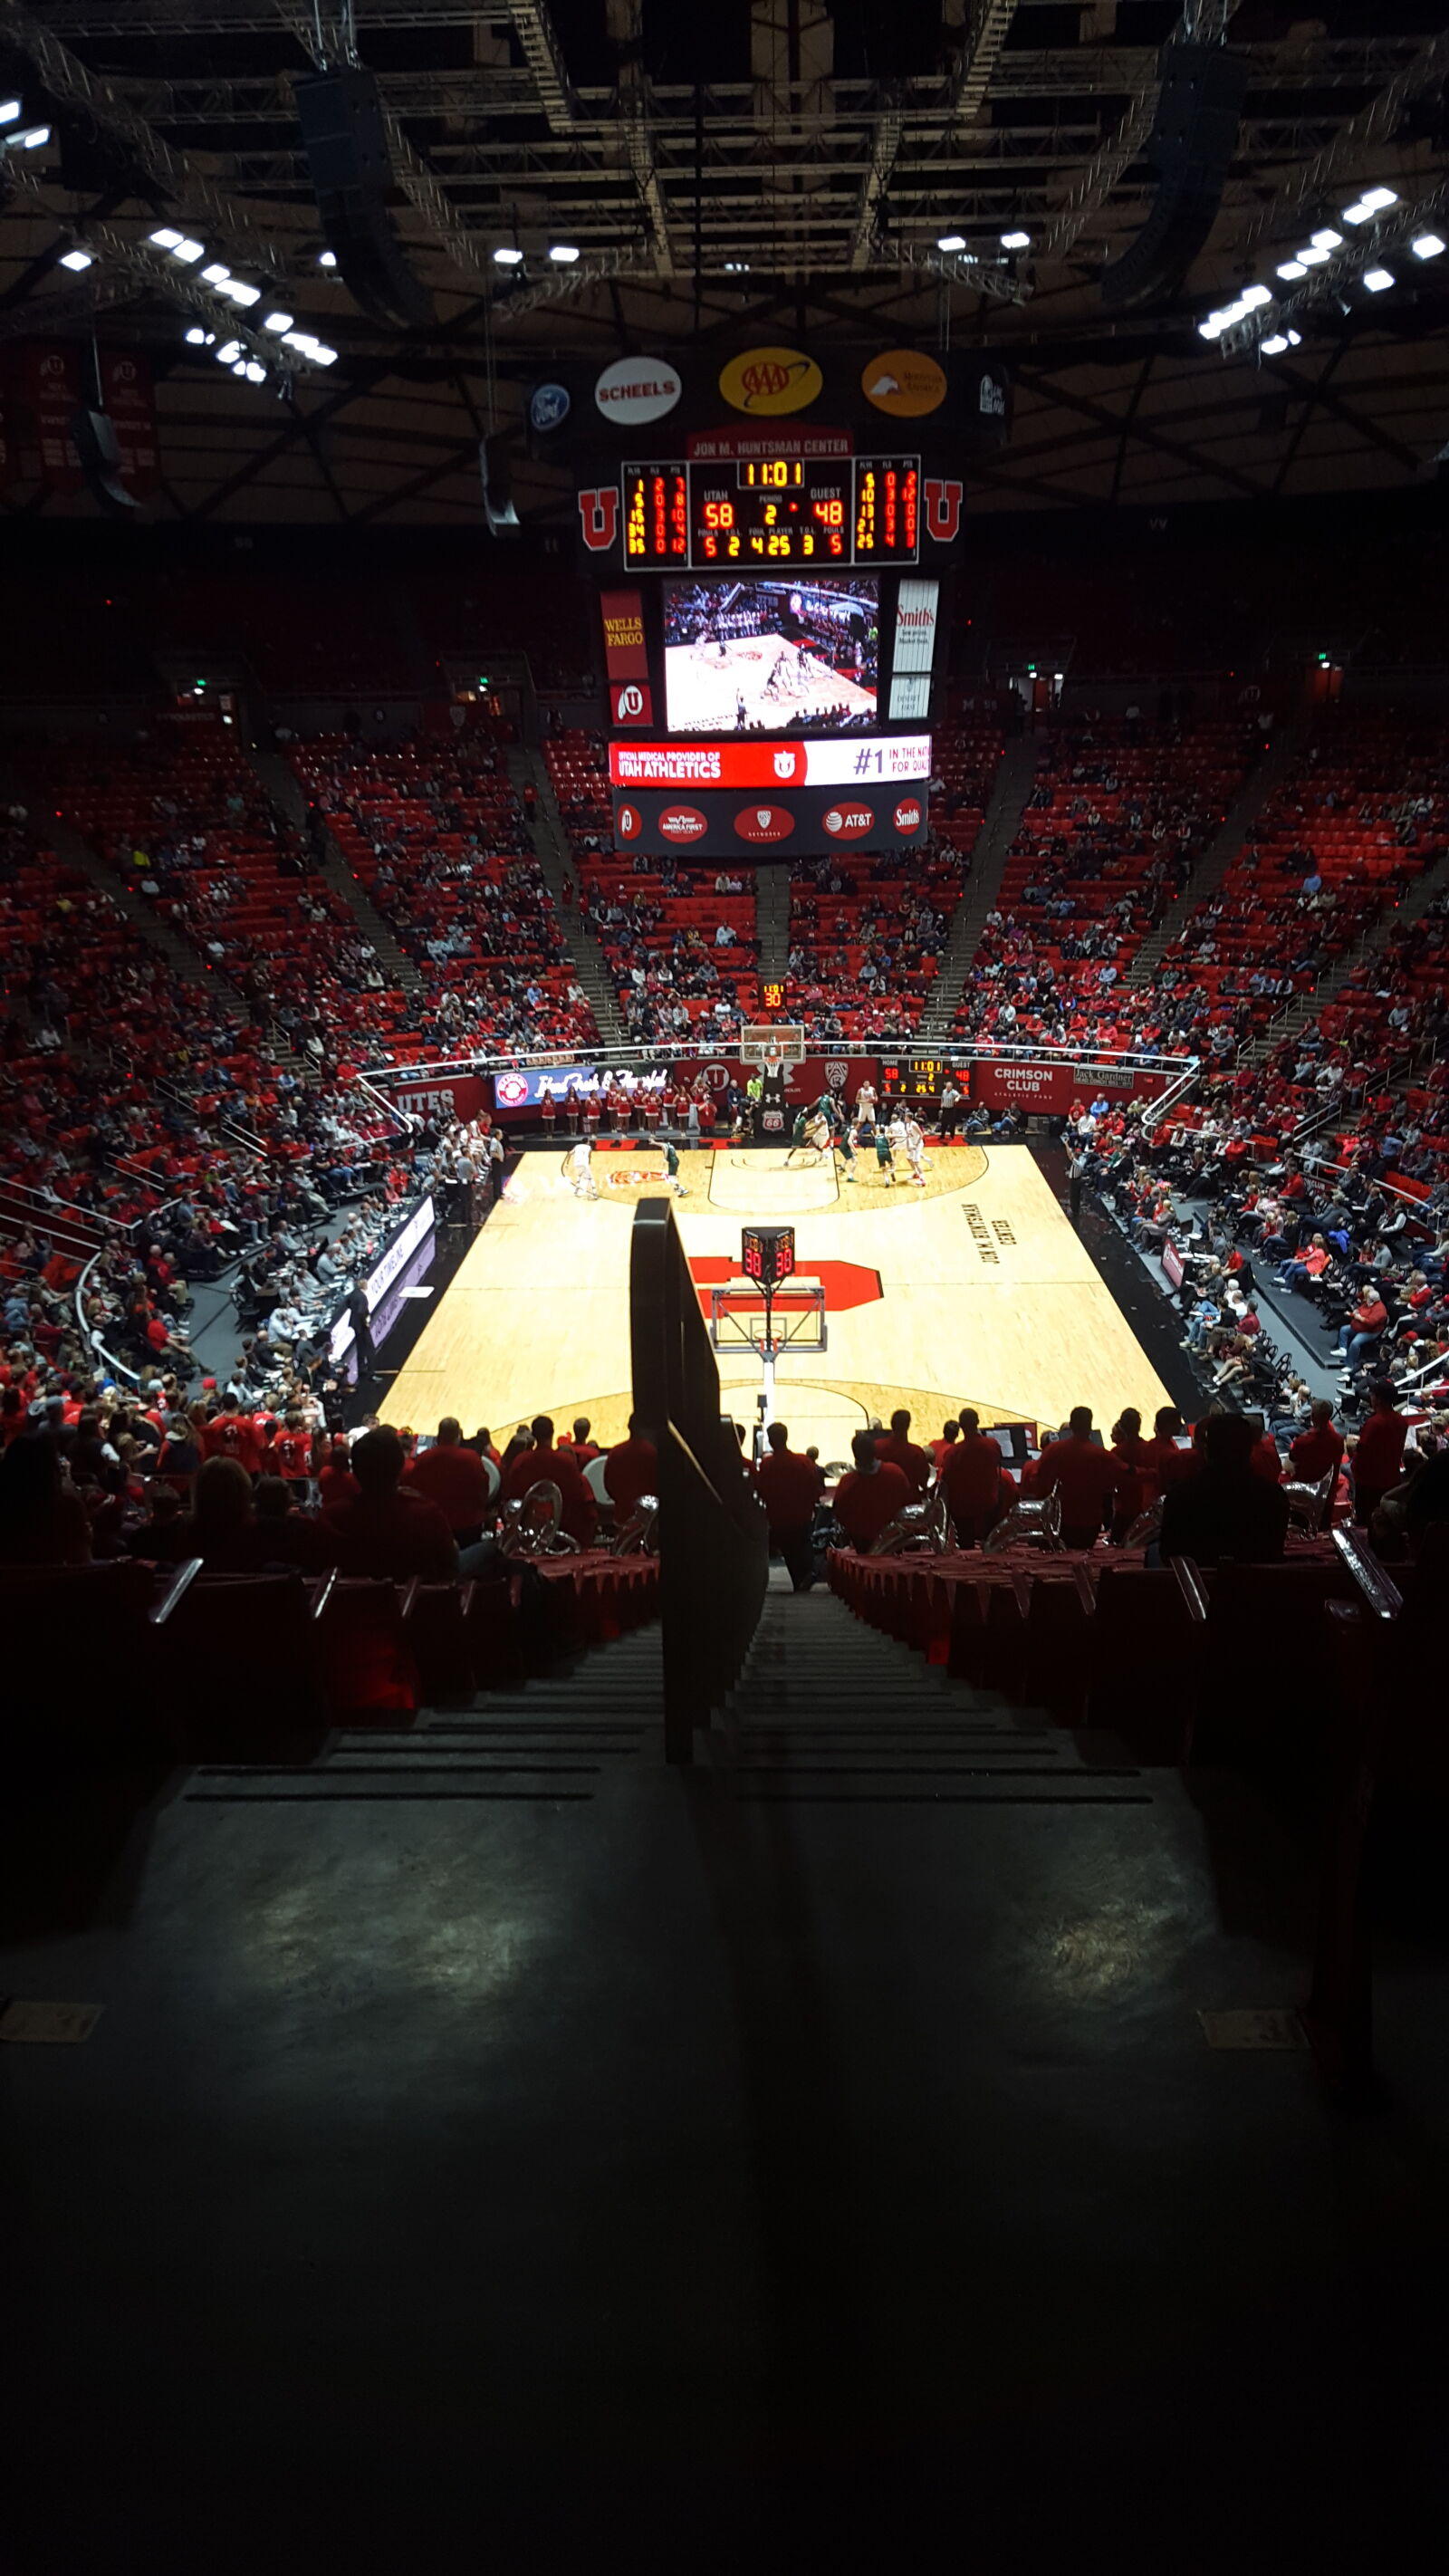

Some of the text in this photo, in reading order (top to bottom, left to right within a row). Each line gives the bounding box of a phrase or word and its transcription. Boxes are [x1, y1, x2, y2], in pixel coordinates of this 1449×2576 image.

[747, 362, 782, 395] AAA
[599, 381, 676, 402] SCHEELS
[694, 439, 849, 456] JON M. HUNTSMAN CENTER
[748, 460, 801, 487] 11:01
[866, 470, 917, 488] 5 0 2
[638, 478, 644, 493] 1
[655, 476, 665, 492] 2
[655, 492, 666, 508] 0
[704, 490, 728, 502] UTAH
[810, 487, 841, 499] GUEST
[861, 488, 875, 503] 10
[901, 487, 917, 502] 12
[631, 508, 645, 524] 15
[671, 508, 686, 523] 10
[704, 502, 734, 530] 58
[764, 504, 777, 526] 2
[813, 500, 844, 526] 48
[886, 503, 896, 518] 0
[907, 503, 916, 518] 0
[924, 478, 964, 542] U
[578, 486, 619, 551] U
[857, 518, 875, 533] 21
[907, 517, 916, 533] 0
[656, 524, 666, 538] 0
[656, 538, 667, 554] 0
[671, 537, 686, 554] 12
[704, 533, 843, 558] 5 2 4 25 3 5
[857, 533, 875, 549] 25
[897, 603, 935, 627] Smith's
[604, 617, 642, 632] WELLS
[607, 631, 644, 647] FARGO
[626, 692, 639, 710] U
[638, 751, 666, 762] MEDICAL
[666, 751, 706, 762] PROVIDER
[707, 751, 721, 761] OF
[853, 747, 883, 775] #1
[888, 748, 898, 760] IN
[902, 747, 916, 759] THE
[618, 761, 722, 779] UTAH ATHLETICS
[892, 762, 909, 773] FOR
[662, 822, 686, 831] AMERICA
[686, 823, 704, 831] FIRST
[844, 812, 872, 828] AT&T
[764, 992, 782, 1008] 30
[884, 1067, 899, 1080] 58
[914, 1061, 941, 1072] 11:01
[994, 1068, 1053, 1081] CRIMSON
[601, 1071, 613, 1091] &
[927, 1072, 935, 1081] 2
[955, 1070, 970, 1081] 48
[1076, 1068, 1132, 1082] Jack Gardner
[884, 1082, 936, 1093] 5 2 25 4
[963, 1085, 970, 1095] 5
[1006, 1080, 1041, 1092] CLUB
[396, 1089, 455, 1114] UTES
[765, 1119, 780, 1128] 66
[961, 1203, 991, 1239] HUNTSMAN
[991, 1219, 1017, 1245] CENTER
[979, 1251, 1001, 1264] JON
